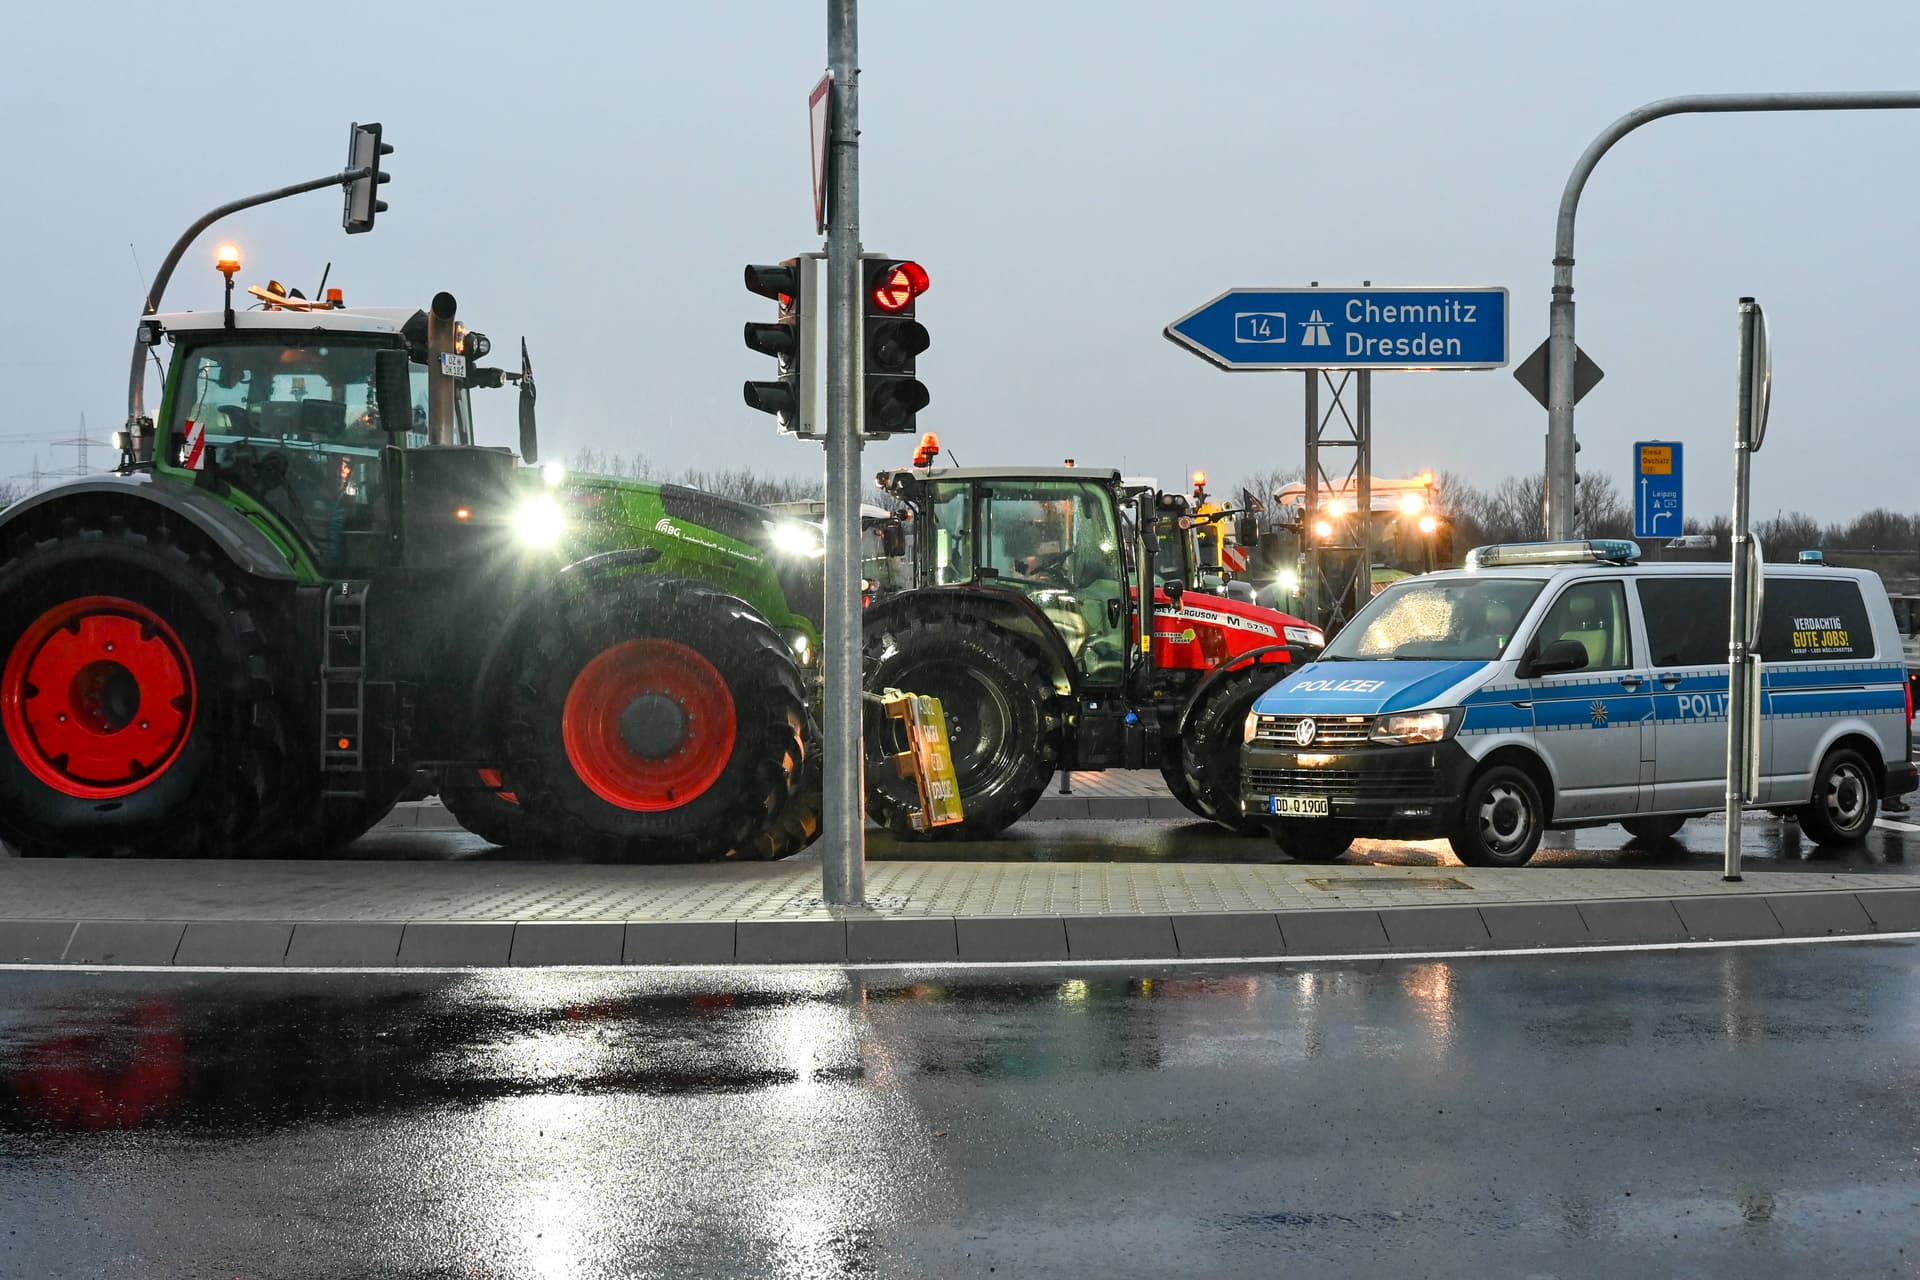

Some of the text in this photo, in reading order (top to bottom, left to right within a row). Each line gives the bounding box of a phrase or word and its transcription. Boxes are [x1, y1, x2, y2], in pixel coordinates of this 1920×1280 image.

[1345, 299, 1477, 323] Chemnitz
[1250, 318, 1271, 337] 14
[1345, 332, 1461, 356] Dresden
[1652, 490, 1677, 498] Leipzig
[1174, 608, 1218, 621] RGUSON
[1227, 615, 1240, 627] M
[1793, 630, 1849, 648] GUTE JOBS!
[1288, 679, 1385, 694] POLIZEI
[1677, 694, 1729, 718] POLIZ
[1276, 798, 1288, 812] DD
[1302, 799, 1327, 813] 1900
